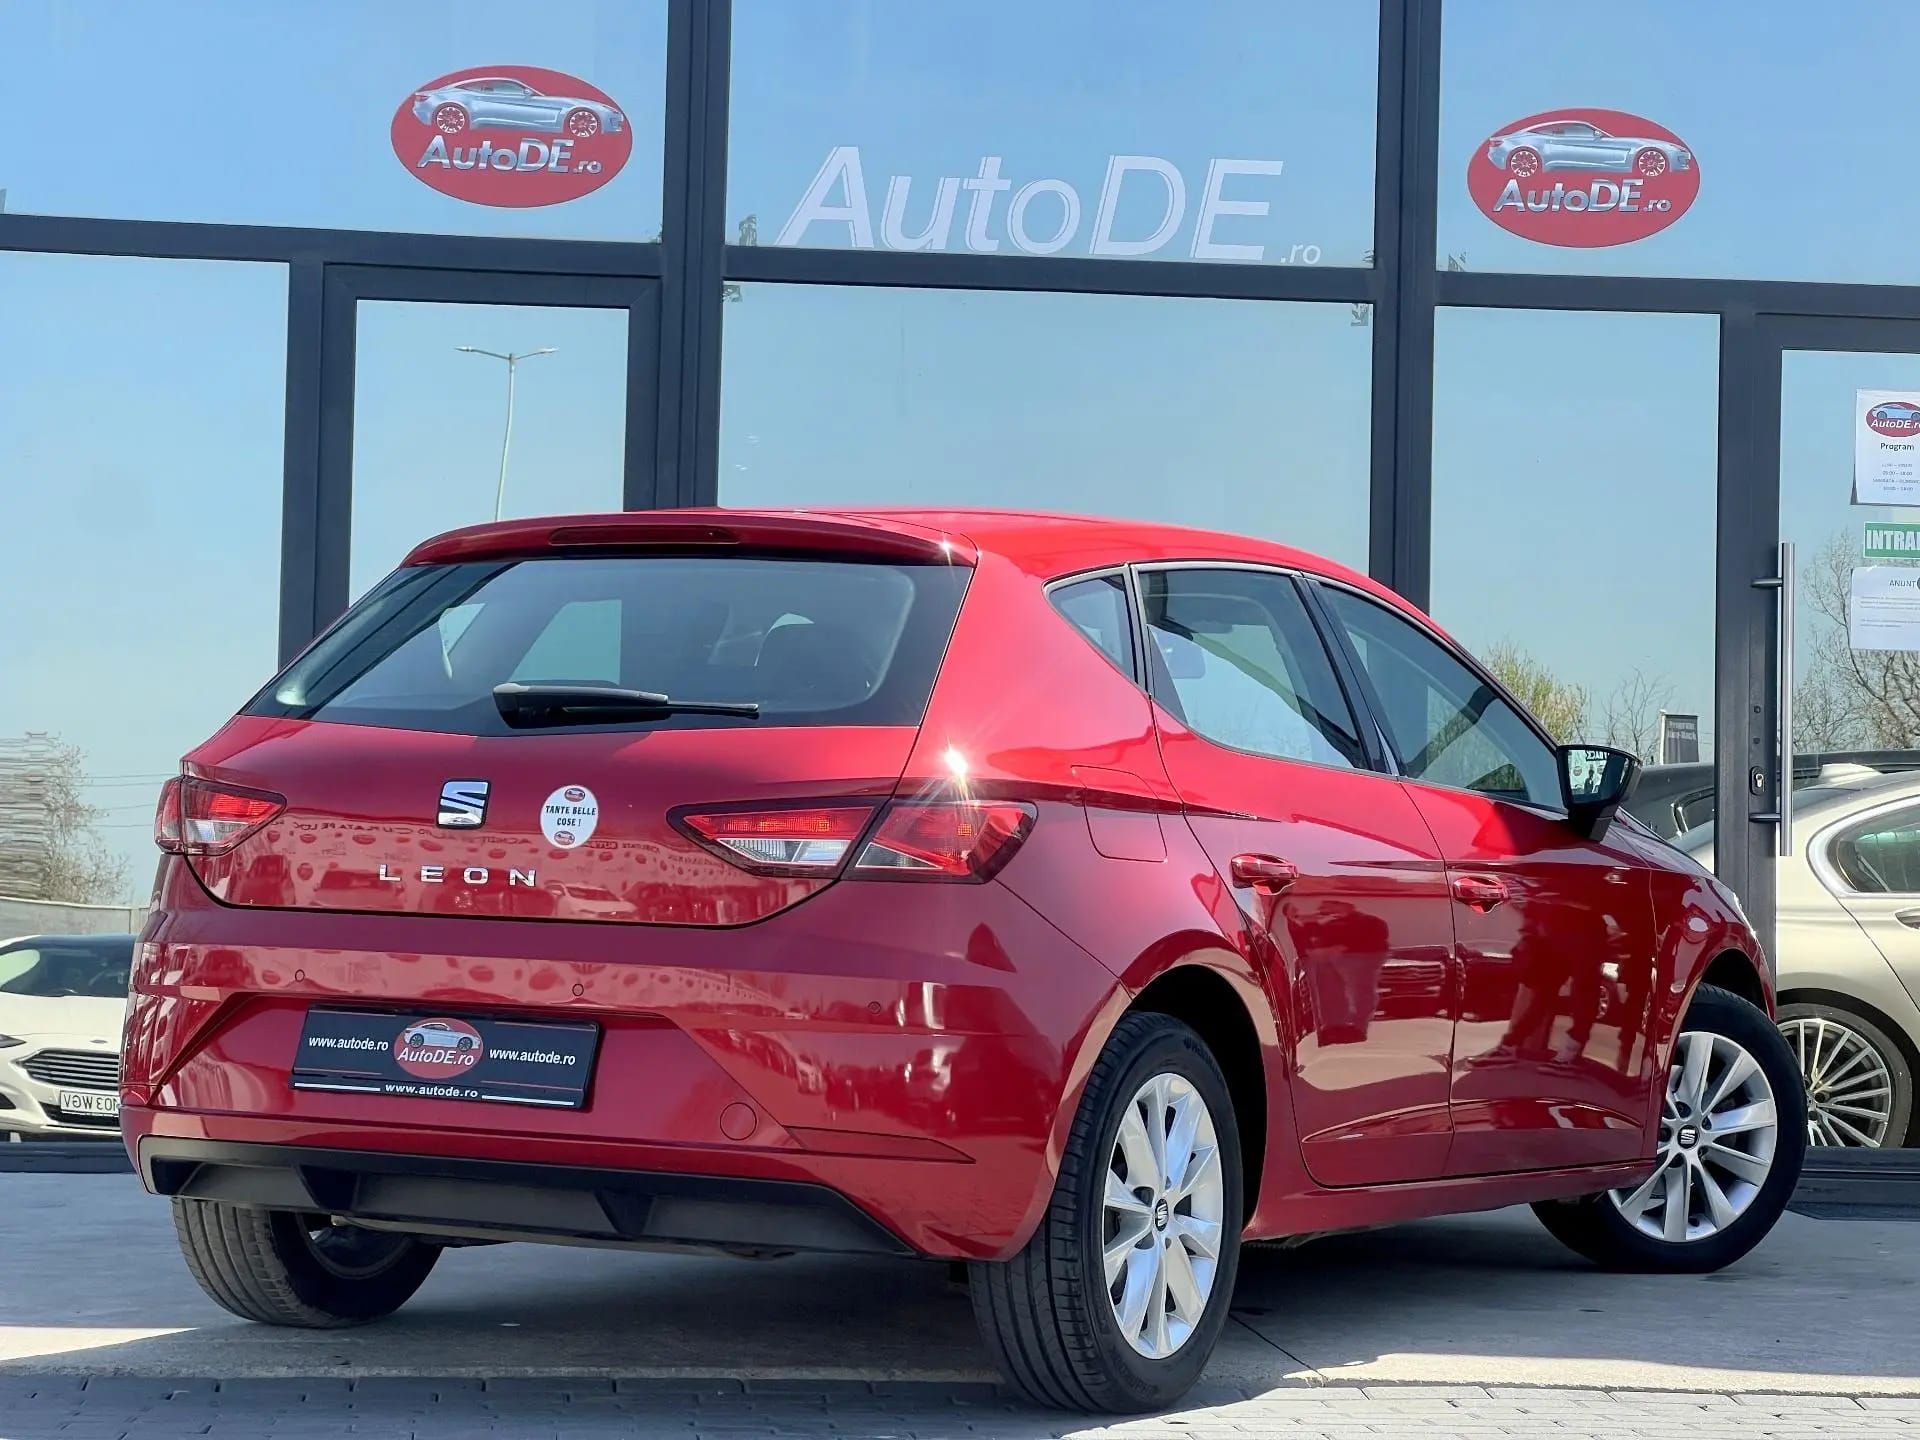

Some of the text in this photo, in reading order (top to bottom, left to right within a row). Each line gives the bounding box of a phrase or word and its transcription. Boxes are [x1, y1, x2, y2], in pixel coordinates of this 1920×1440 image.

[416, 134, 604, 174] AutoDE.ro
[1493, 178, 1672, 213] AutoDE.ro
[1880, 442, 1915, 451] Program
[545, 805, 597, 816] TANTE BELLE
[556, 817, 576, 827] COSE
[379, 863, 537, 887] LEON
[308, 1036, 389, 1051] www.autode.ro
[397, 1047, 474, 1066] AutoDE.ro
[489, 1047, 576, 1066] www.autode.ro
[385, 1083, 478, 1099] www.autode.ro
